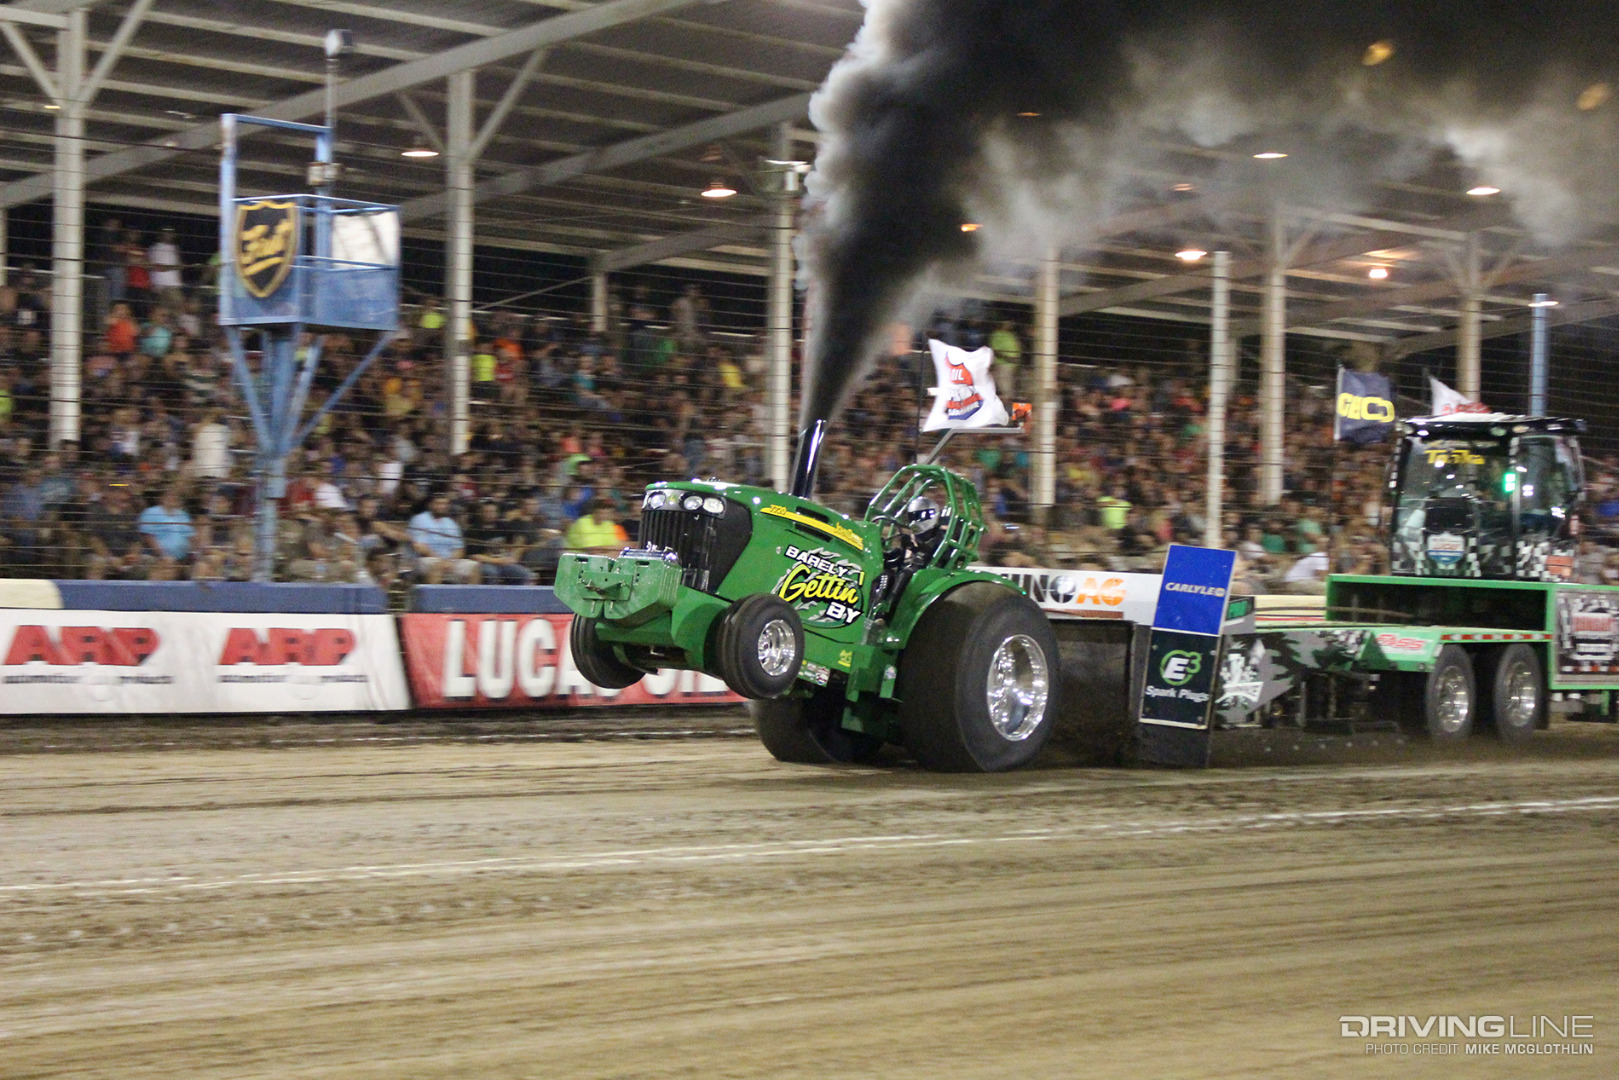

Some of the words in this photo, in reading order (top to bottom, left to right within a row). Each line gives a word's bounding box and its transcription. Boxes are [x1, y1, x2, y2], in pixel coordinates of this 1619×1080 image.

[785, 545, 848, 577] BARELY
[1165, 582, 1216, 596] CARLYLE
[826, 601, 861, 623] BY
[3, 625, 160, 666] ARP
[218, 627, 356, 666] ARP
[443, 619, 622, 698] LUCA
[1145, 685, 1177, 698] Spark
[1178, 688, 1210, 703] Plugs
